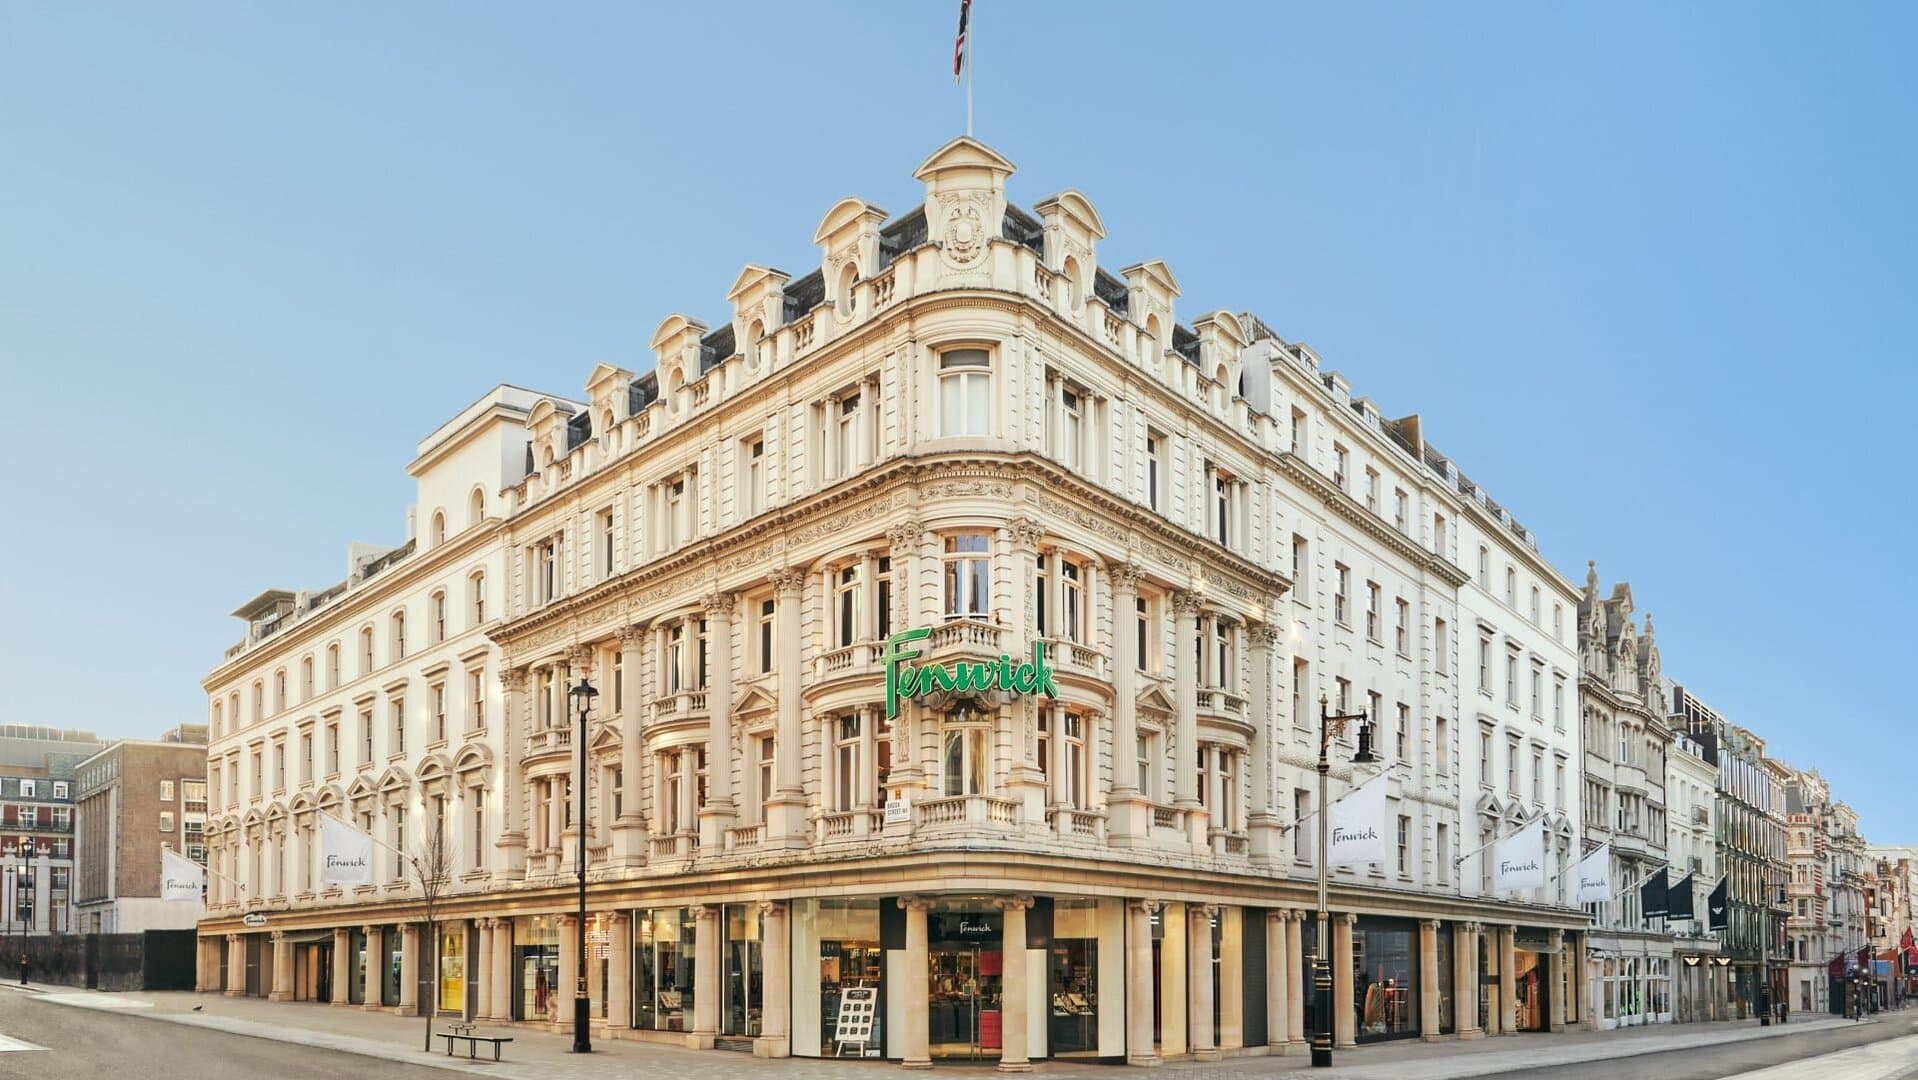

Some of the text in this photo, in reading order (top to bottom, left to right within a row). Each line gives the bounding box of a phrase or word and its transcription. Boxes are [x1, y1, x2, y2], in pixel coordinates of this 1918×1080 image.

[881, 626, 1060, 720] Fenwick
[1332, 826, 1378, 846] Fenwick
[327, 854, 366, 868] Fenwick
[1501, 860, 1539, 875] Fenwick
[166, 880, 198, 890] Fenwick
[1581, 877, 1607, 890] Fenwick
[246, 917, 265, 925] Fenwick
[960, 921, 992, 934] Fenwick
